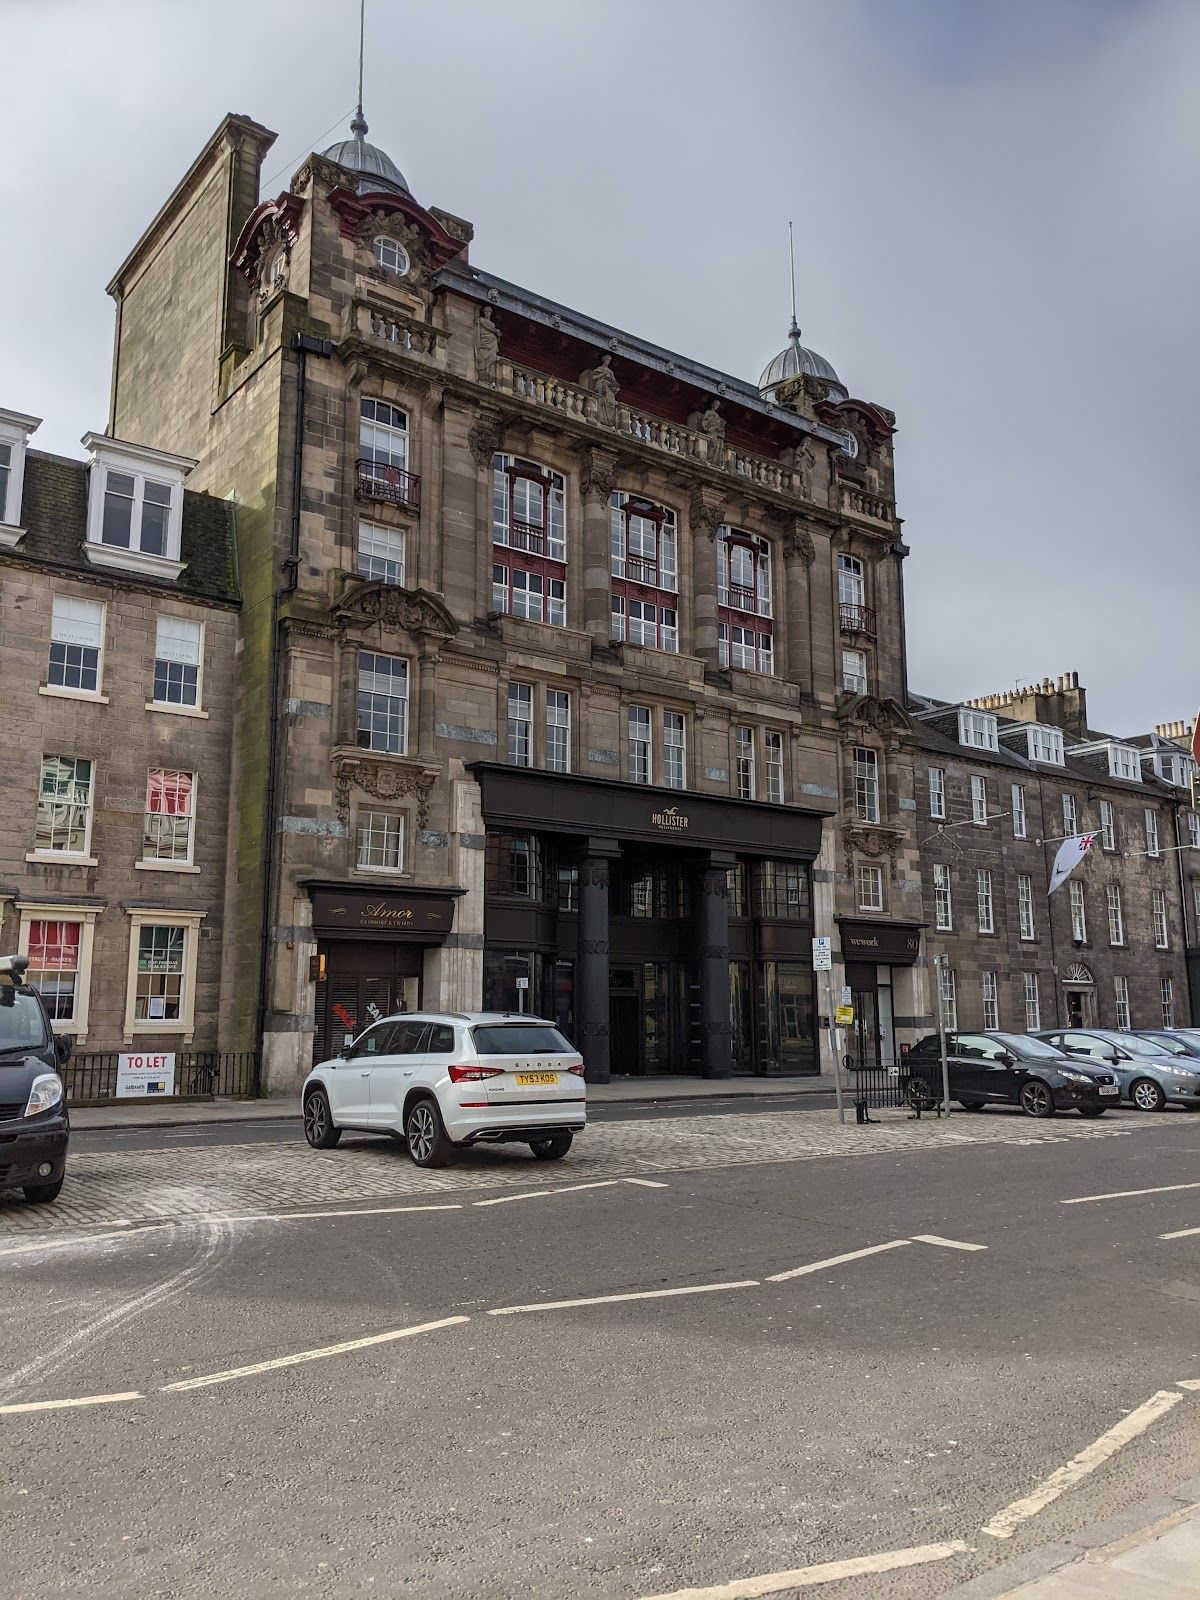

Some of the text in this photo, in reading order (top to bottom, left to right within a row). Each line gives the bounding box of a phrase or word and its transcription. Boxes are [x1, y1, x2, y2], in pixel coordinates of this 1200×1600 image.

[652, 813, 688, 828] HOLLISTER
[360, 902, 414, 919] Amor
[850, 937, 918, 949] wework 80
[127, 1056, 167, 1069] TO LET
